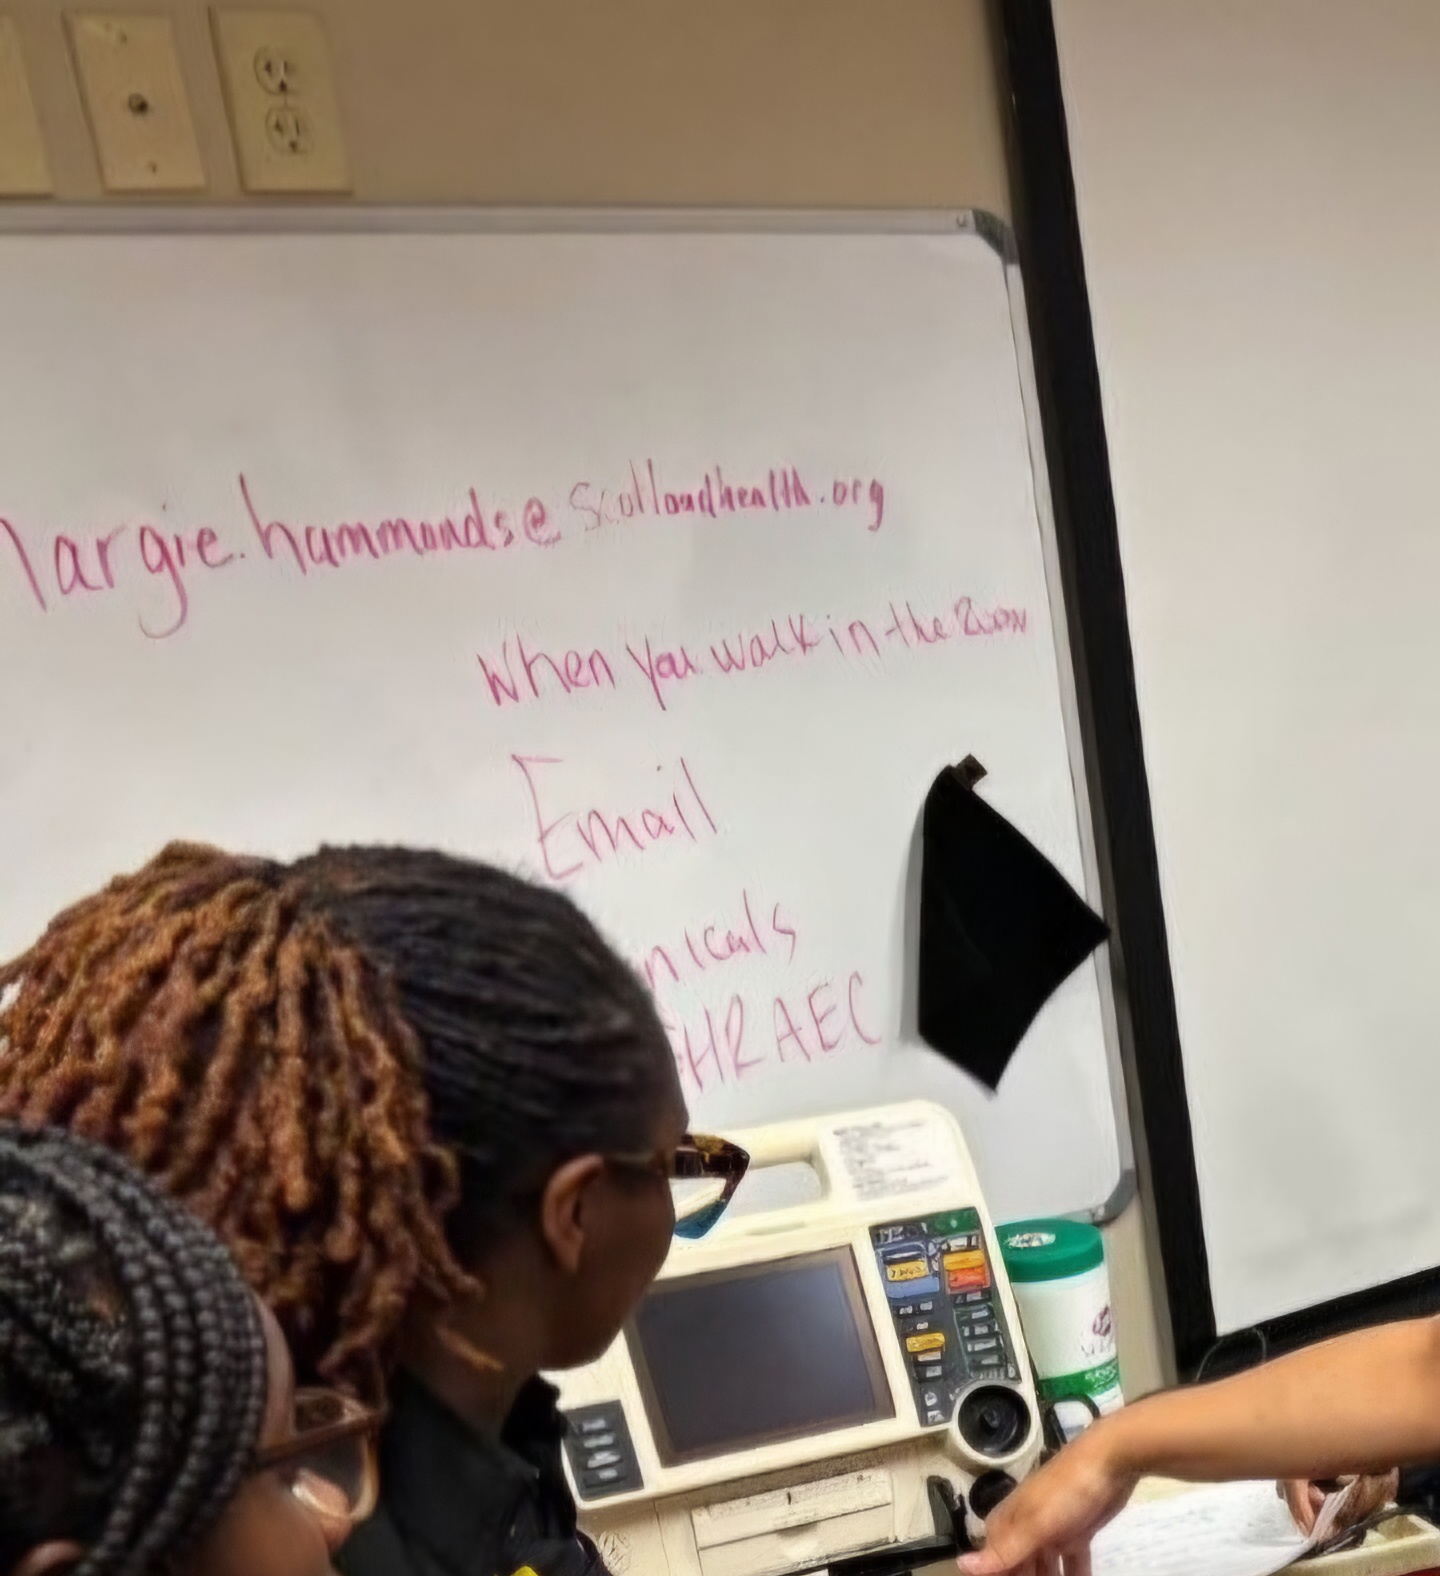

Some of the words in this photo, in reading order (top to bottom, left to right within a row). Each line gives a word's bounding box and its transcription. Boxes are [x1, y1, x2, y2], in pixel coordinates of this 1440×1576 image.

[477, 634, 617, 707] When
[709, 613, 823, 675] walk
[826, 614, 881, 660] in
[884, 599, 951, 650] the
[510, 753, 719, 880] Email
[643, 887, 797, 991] nicals
